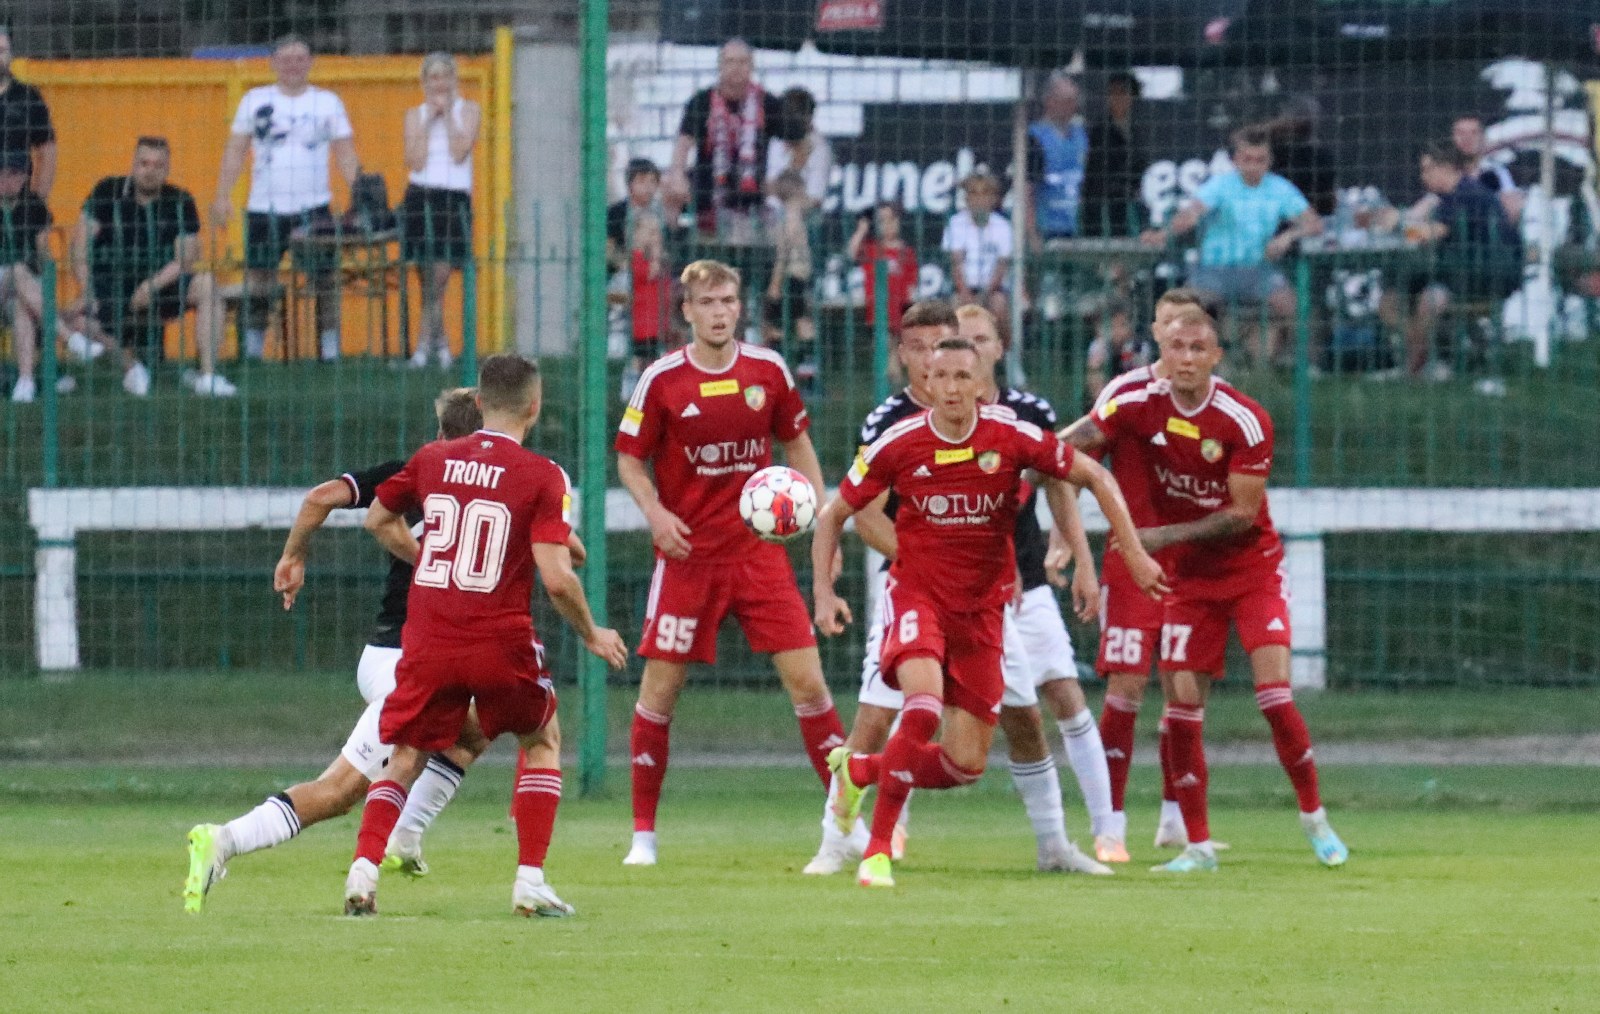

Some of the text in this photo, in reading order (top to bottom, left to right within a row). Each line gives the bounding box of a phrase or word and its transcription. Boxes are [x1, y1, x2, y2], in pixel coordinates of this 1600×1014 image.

[684, 436, 767, 464] VOTUM
[443, 459, 505, 489] TRONT
[911, 492, 1004, 516] VOTUM
[414, 493, 512, 594] 20
[655, 613, 698, 654] 95
[899, 609, 919, 645] 6
[1104, 626, 1143, 665] 26
